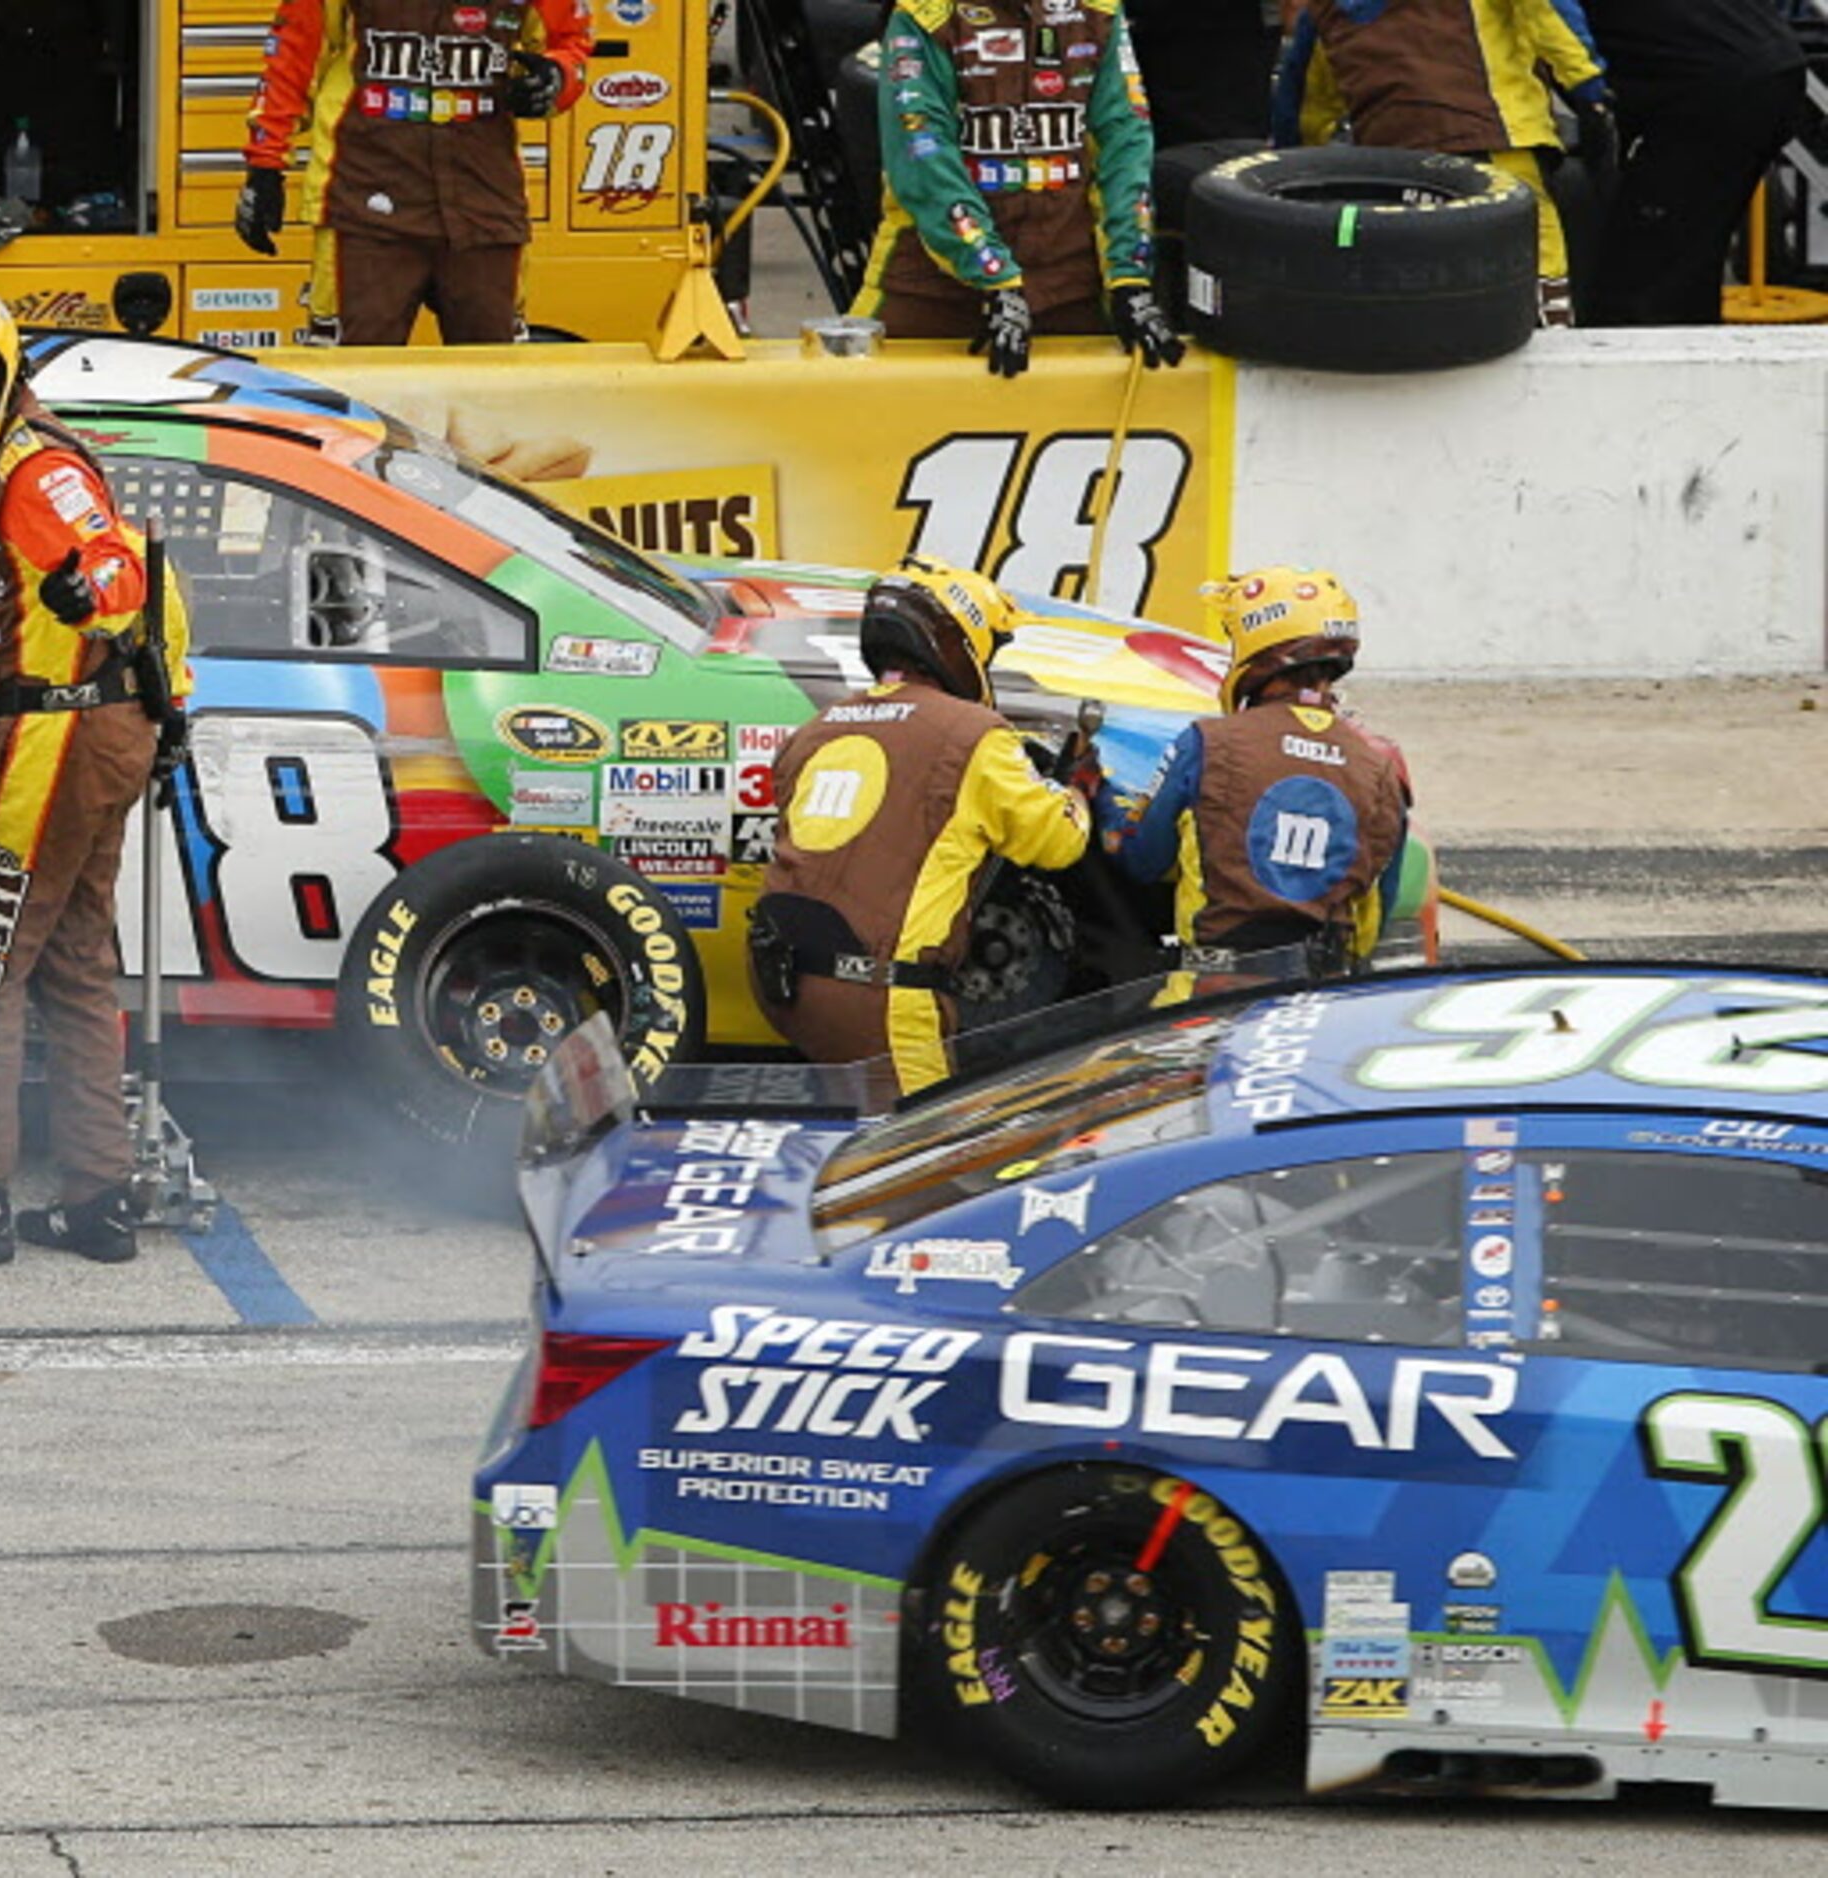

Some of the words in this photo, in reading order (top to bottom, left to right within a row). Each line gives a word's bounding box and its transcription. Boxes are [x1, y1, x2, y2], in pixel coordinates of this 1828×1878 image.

[578, 123, 675, 193] 18
[195, 291, 273, 307] SIEMENS
[203, 330, 257, 348] Mobil
[894, 430, 1194, 618] 18
[1282, 734, 1346, 766] ODELL
[609, 767, 690, 791] Mobil
[698, 767, 726, 790] 1
[738, 764, 777, 809] 3
[803, 769, 863, 818] m
[620, 838, 708, 857] LINCOLN
[633, 816, 722, 835] freescale
[1271, 812, 1329, 868] m
[638, 858, 715, 873] WELDERS
[366, 898, 420, 1027] EAGLE
[1701, 1119, 1795, 1140] CW
[646, 1160, 764, 1255] GEAR
[678, 1306, 982, 1372] SPEED
[673, 1366, 947, 1442] STICK
[999, 1331, 1518, 1459] GEAR
[638, 1448, 812, 1477] SUPERIOR
[820, 1459, 933, 1487] SWEAT
[678, 1476, 890, 1511] PROTECTION
[653, 1602, 854, 1649] Rinnai
[943, 1561, 992, 1707] EAGLE
[1324, 1680, 1403, 1705] ZAK
